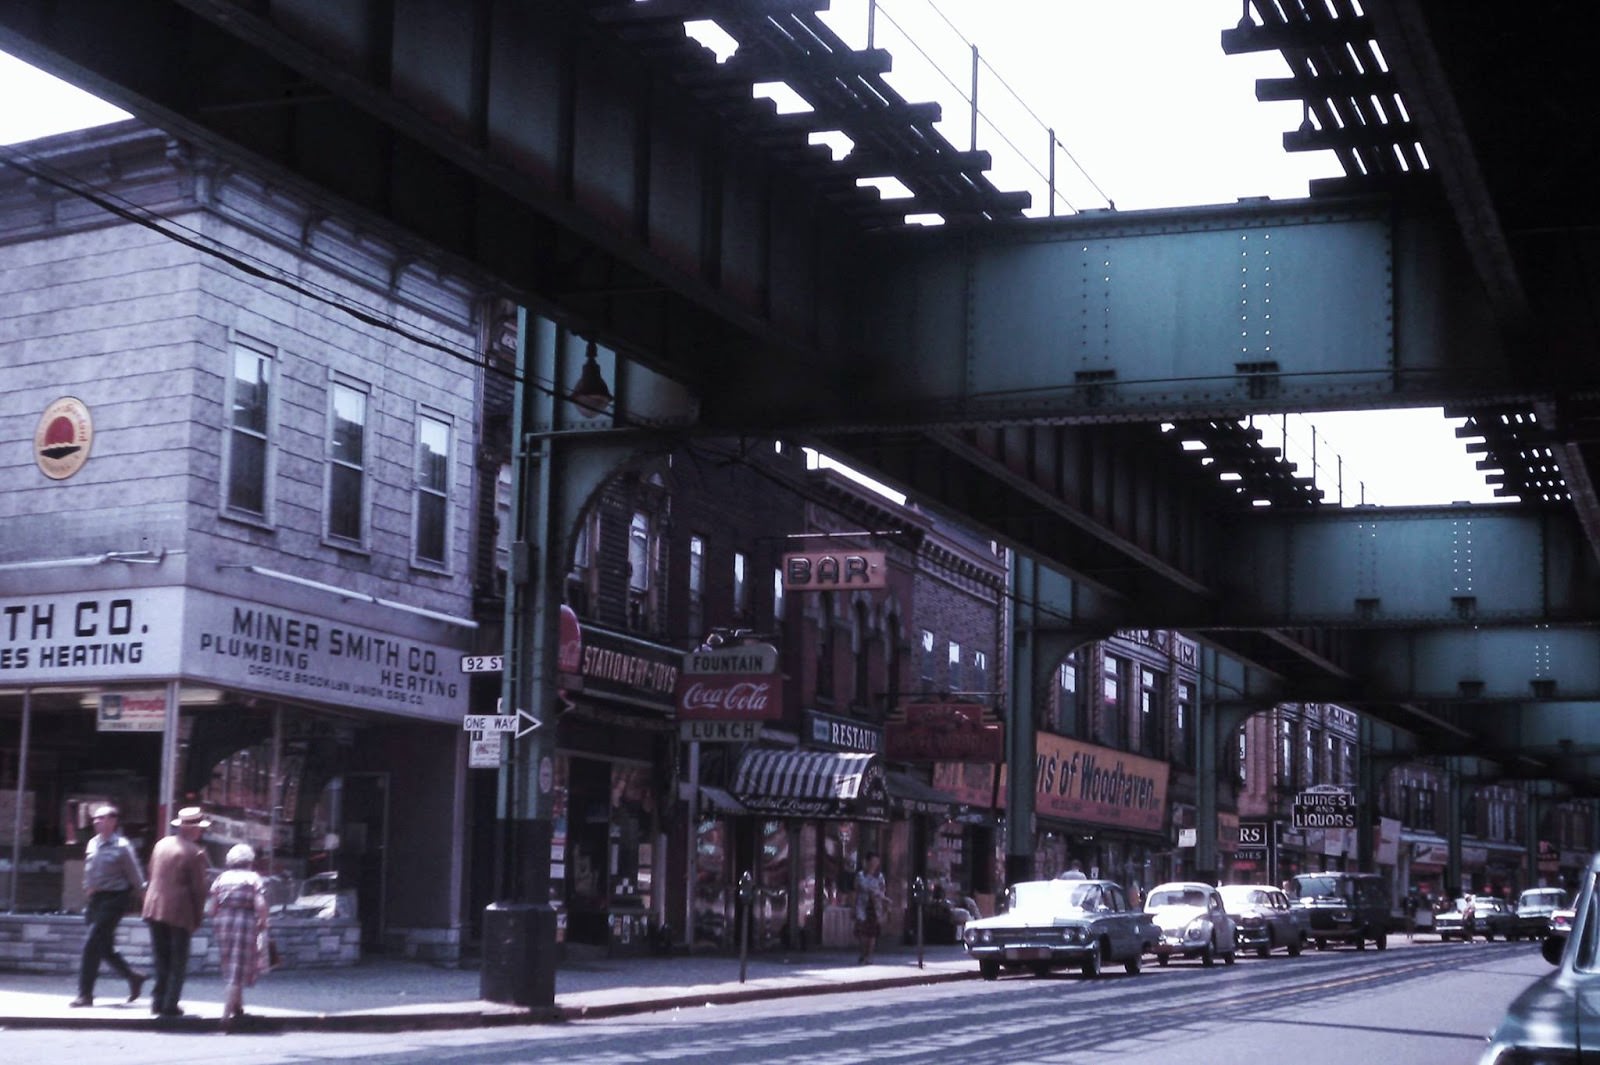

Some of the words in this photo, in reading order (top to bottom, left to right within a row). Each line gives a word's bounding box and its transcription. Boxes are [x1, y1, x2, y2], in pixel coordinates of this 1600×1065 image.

[787, 555, 870, 585] BAR
[4, 604, 55, 642] TH
[75, 599, 149, 637] CO.
[40, 642, 143, 668] HEATING
[200, 632, 309, 671] PLUMBING
[232, 606, 320, 652] MINER
[328, 628, 400, 670] SMITH
[407, 645, 444, 676] CO.
[467, 657, 484, 670] 92
[692, 655, 763, 672] FOUNTAIN
[248, 664, 291, 682] OFFICE
[294, 672, 350, 692] BROOKLYN
[353, 684, 383, 698] UNION
[387, 690, 407, 703] GAS
[380, 669, 458, 699] HEATING
[465, 717, 486, 729] ONE
[494, 717, 517, 729] WAY
[692, 721, 755, 739] LUNCH
[1080, 752, 1154, 809] Woodhaven
[1303, 794, 1347, 807] WINES
[1296, 813, 1355, 828] LIQUORS
